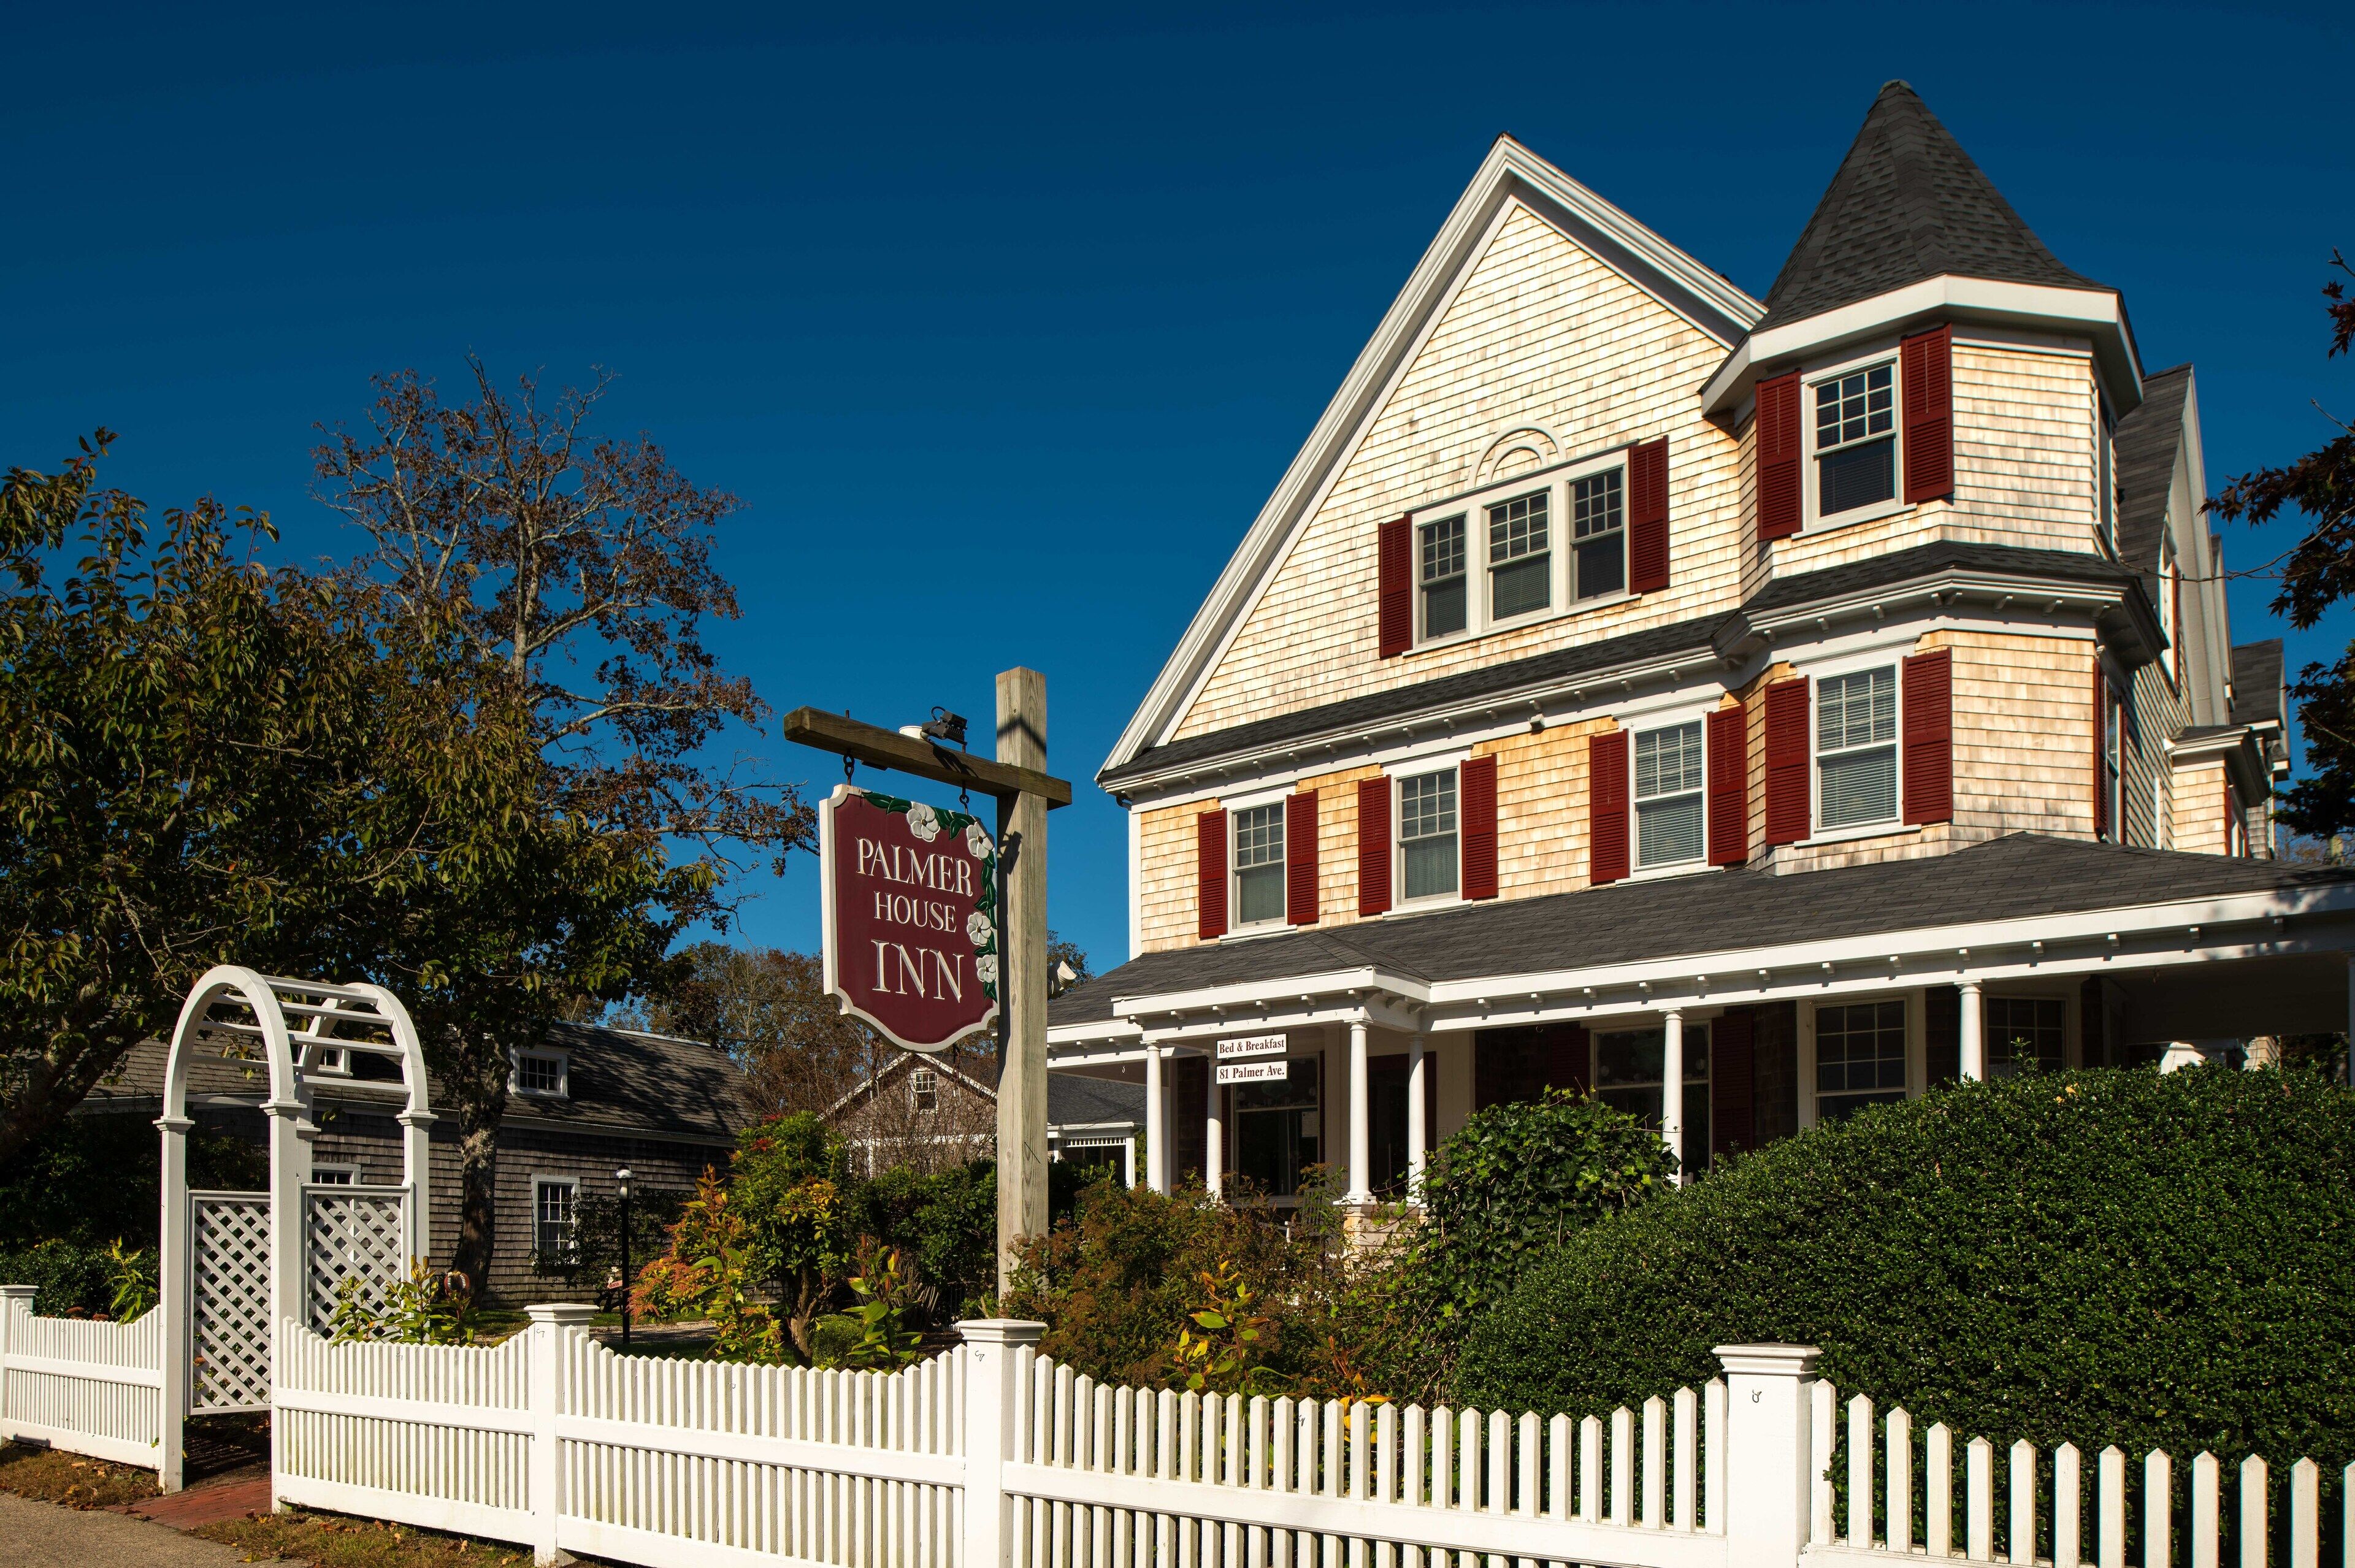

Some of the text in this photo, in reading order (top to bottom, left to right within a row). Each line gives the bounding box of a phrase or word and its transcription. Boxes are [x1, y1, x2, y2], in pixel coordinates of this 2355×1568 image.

[855, 836, 973, 897] PALMER
[873, 890, 957, 933] HOUSE
[871, 939, 964, 1003] INN
[1219, 1038, 1284, 1054] Bed & Breakfast
[1219, 1065, 1285, 1079] 81 Palmer Ave.
